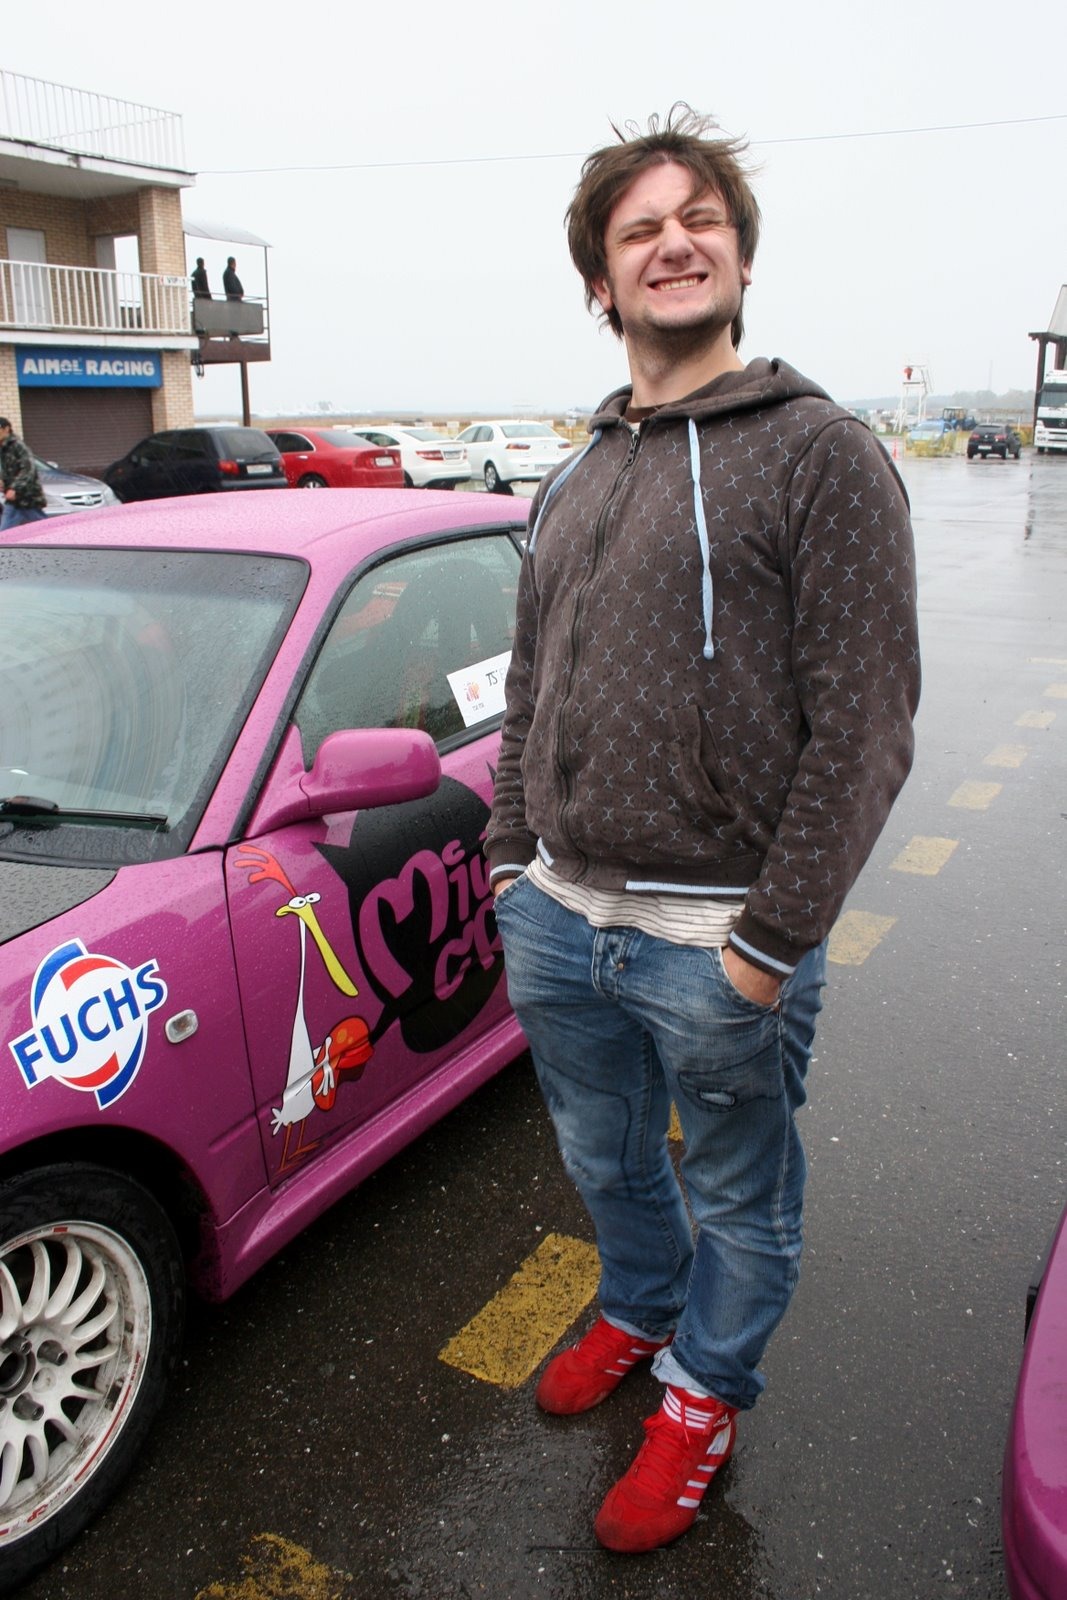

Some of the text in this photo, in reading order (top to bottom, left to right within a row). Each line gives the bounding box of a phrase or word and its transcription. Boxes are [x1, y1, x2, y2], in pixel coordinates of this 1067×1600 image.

[22, 358, 155, 376] AIMOL RACING
[13, 963, 164, 1085] FUCHS
